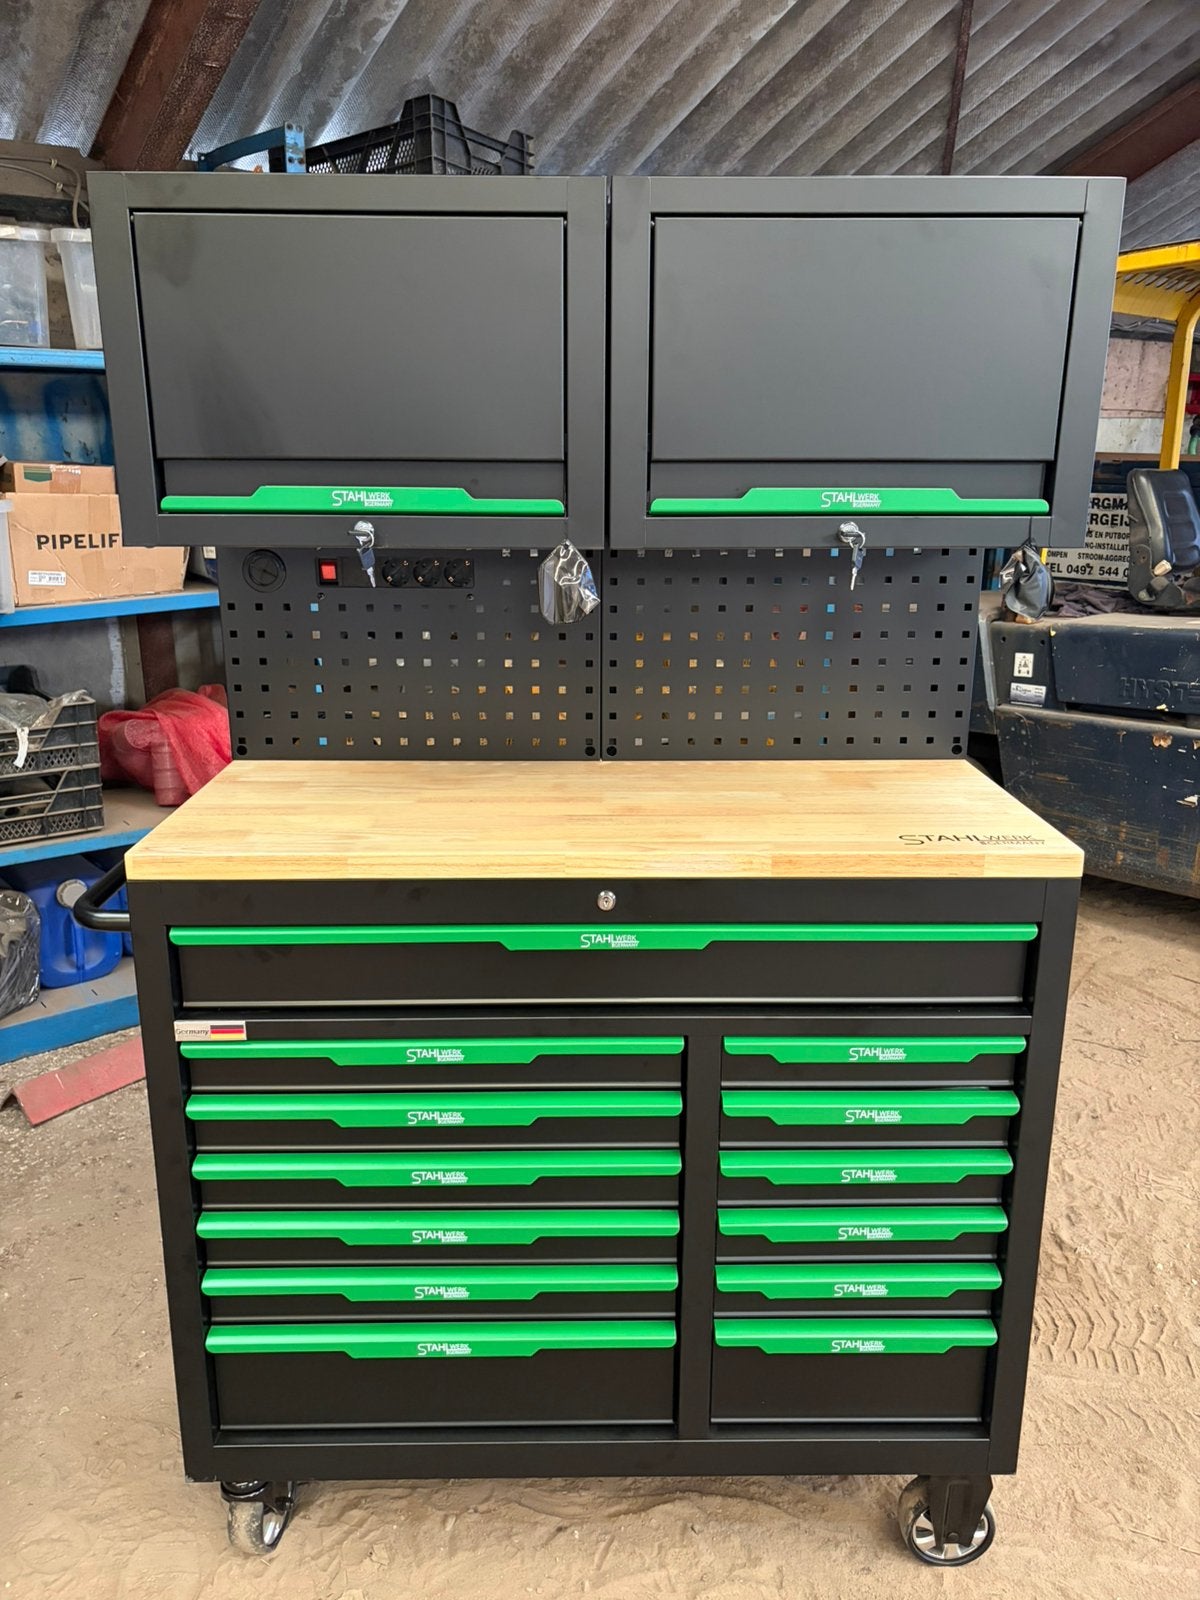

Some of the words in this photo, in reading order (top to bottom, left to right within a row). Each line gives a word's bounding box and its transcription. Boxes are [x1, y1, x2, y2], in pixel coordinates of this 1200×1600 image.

[331, 490, 391, 507] STAHLWERK
[820, 491, 880, 508] STAHLWERK
[1087, 513, 1130, 526] RGEIJ
[1094, 531, 1103, 539] EN
[1085, 542, 1130, 551] NG-INSTALLAT
[1098, 565, 1119, 577] 544
[898, 834, 1033, 845] STAHLWERK
[580, 933, 638, 948] STAHLWERK
[406, 1048, 462, 1063] STAHLWERK
[848, 1047, 905, 1061] STAHLWERK
[407, 1111, 463, 1125] STAHLWERK
[844, 1109, 900, 1123] STAHLWERK
[411, 1171, 466, 1184] STAHLWERK
